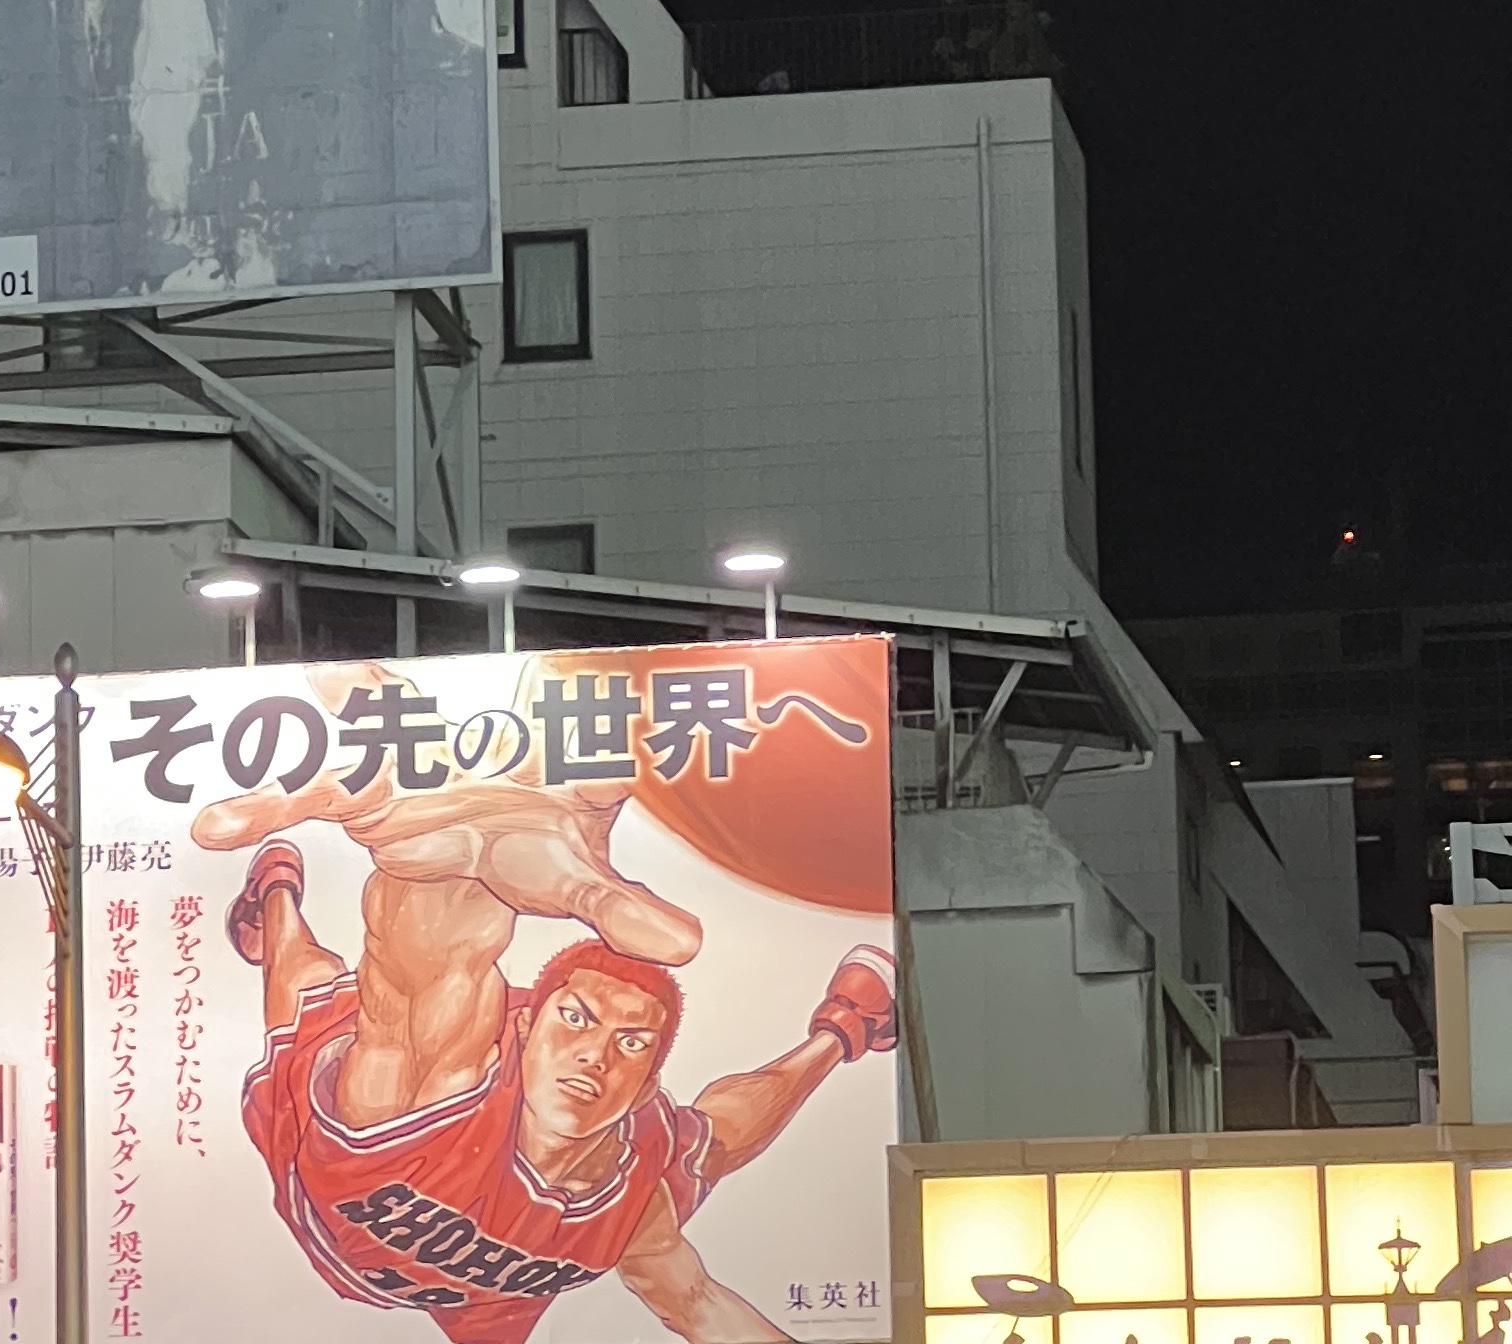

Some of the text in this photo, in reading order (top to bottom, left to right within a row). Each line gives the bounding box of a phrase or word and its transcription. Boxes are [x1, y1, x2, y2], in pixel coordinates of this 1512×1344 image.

[109, 668, 870, 805] その先の世界へ
[106, 899, 143, 1339] 海を渡ったスラムダンク奨学生
[169, 895, 207, 1159] 夢をつかむために、
[785, 1280, 882, 1312] 集英社
